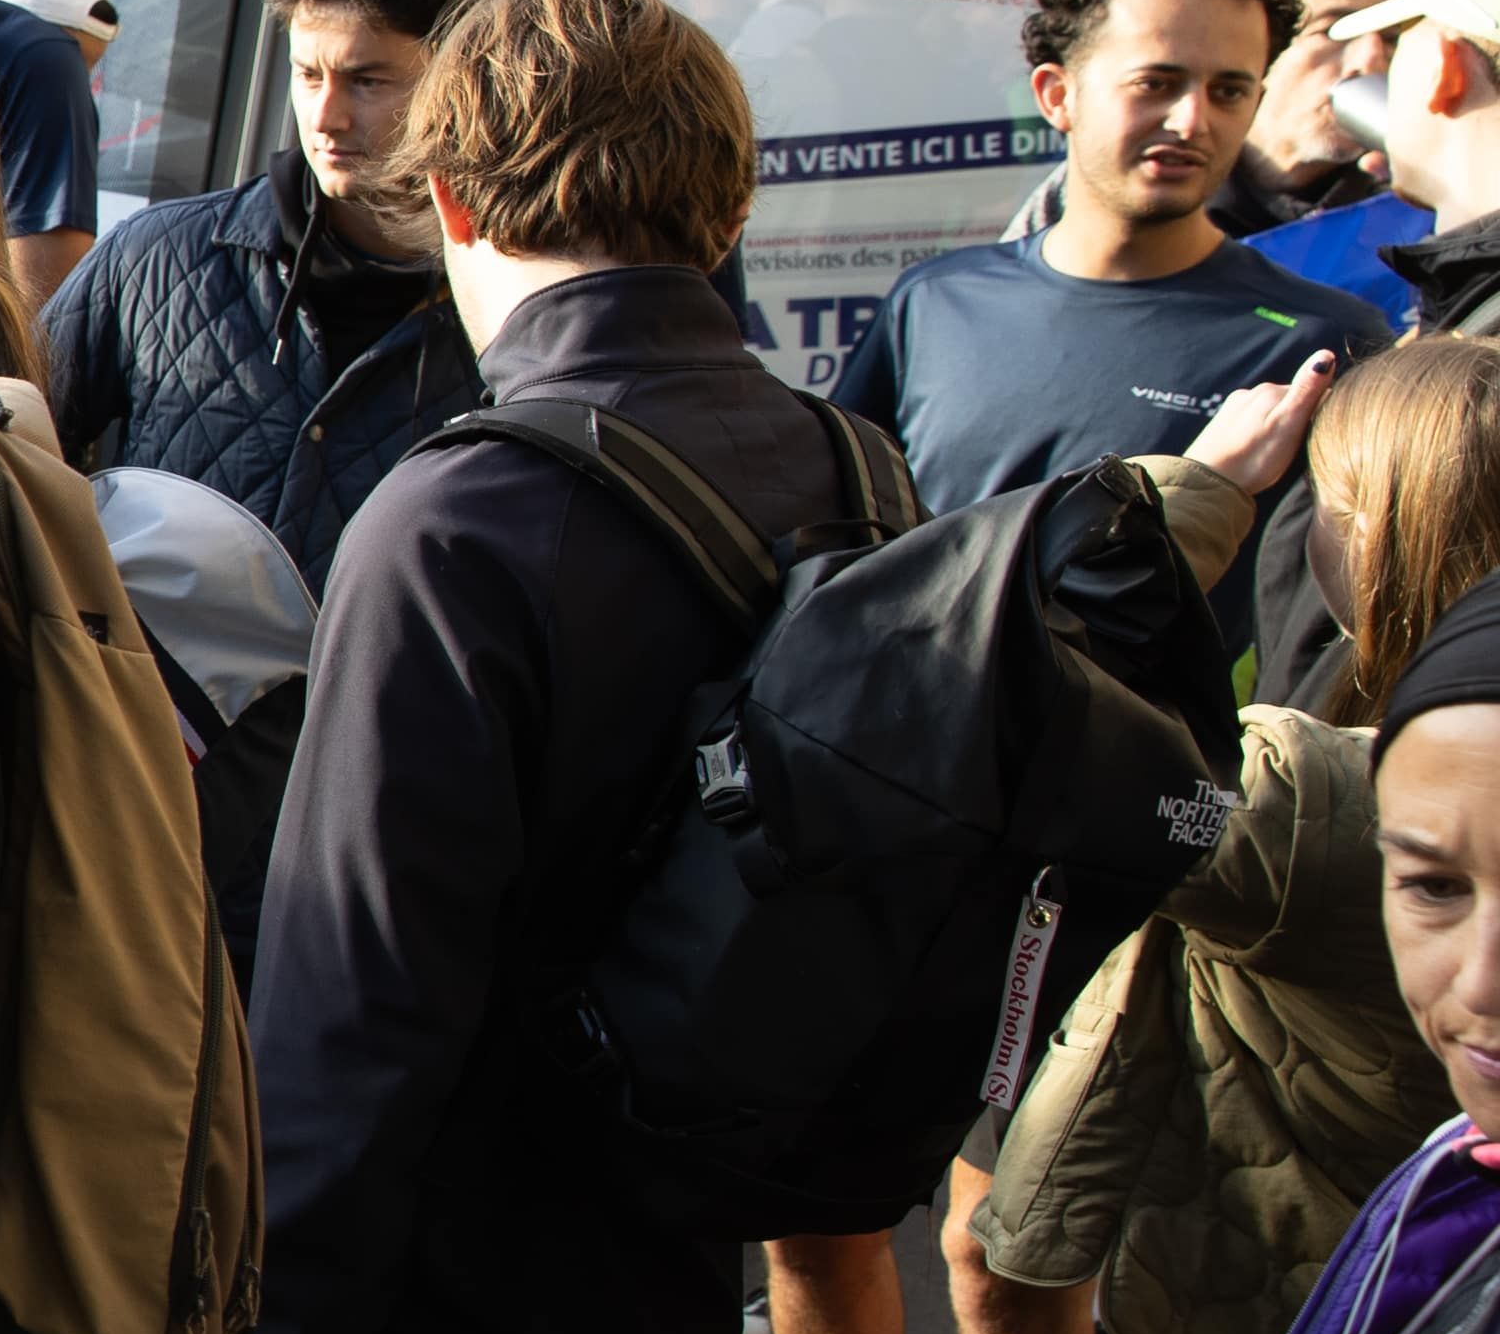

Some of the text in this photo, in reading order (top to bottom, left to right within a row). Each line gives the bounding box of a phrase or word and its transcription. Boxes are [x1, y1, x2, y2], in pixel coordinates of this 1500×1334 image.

[796, 140, 904, 173] VENTE
[913, 136, 955, 163] ICI
[965, 131, 1003, 159] LE
[1012, 128, 1068, 156] DIM
[744, 247, 845, 274] évisions
[851, 245, 895, 268] des
[1131, 386, 1197, 407] VINCI
[1157, 795, 1223, 828] NORTH
[1168, 820, 1216, 847] FACE
[995, 933, 1043, 1068] Stockholm
